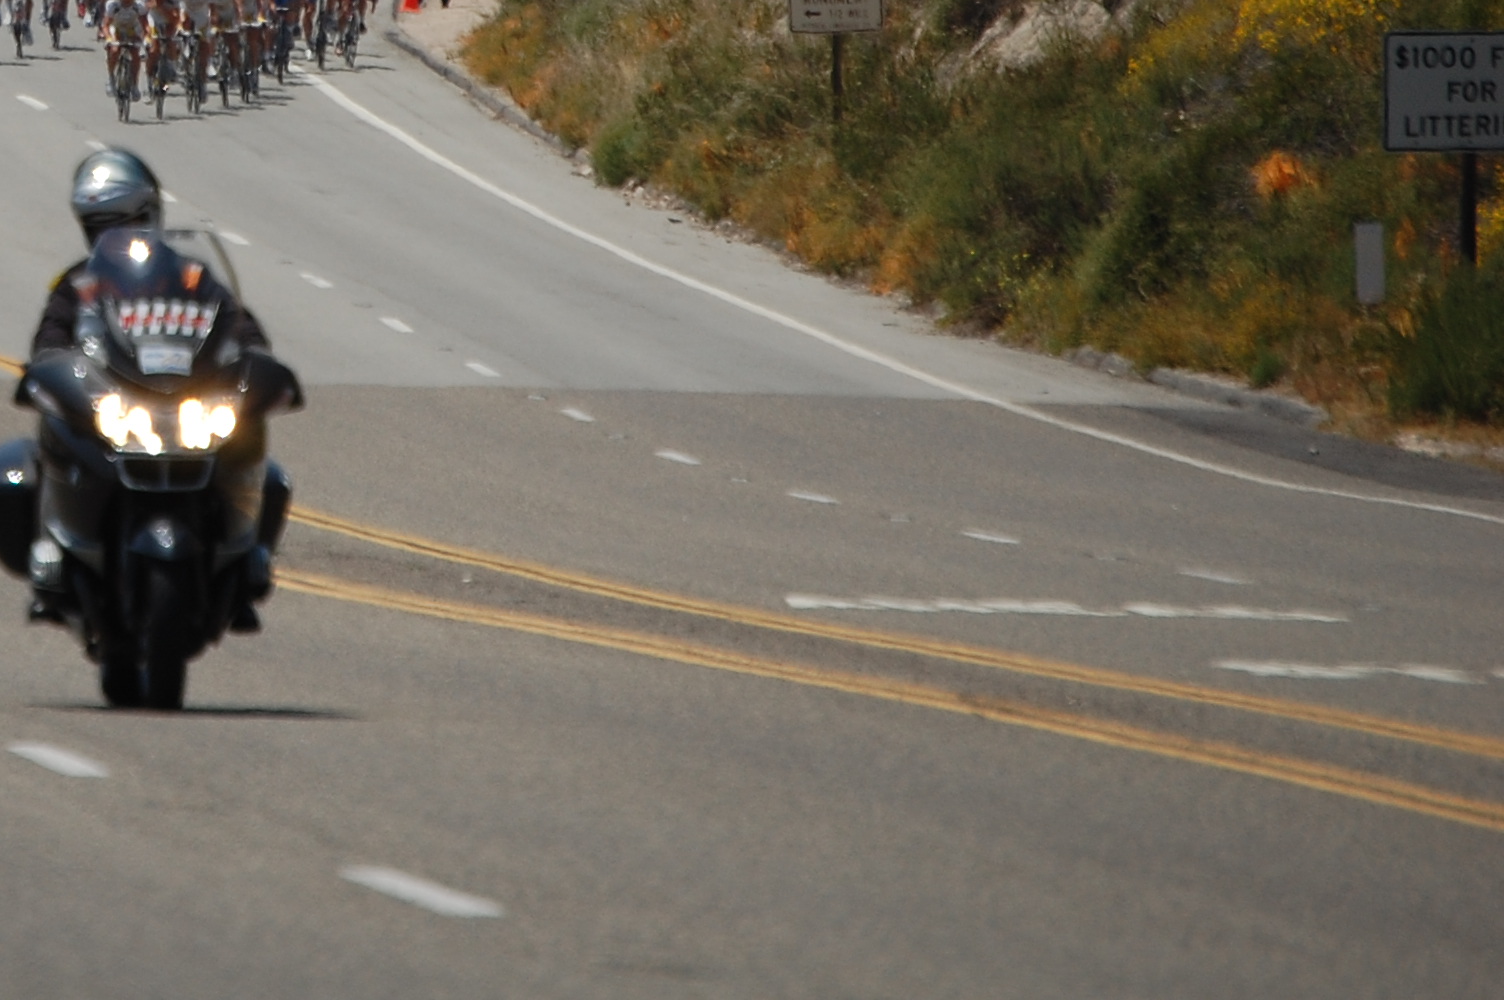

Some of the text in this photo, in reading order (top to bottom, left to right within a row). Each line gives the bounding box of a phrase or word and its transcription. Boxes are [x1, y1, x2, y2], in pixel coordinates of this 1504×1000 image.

[1395, 45, 1476, 70] $1000
[1447, 80, 1497, 103] FOR
[1404, 114, 1504, 138] LITTERI
